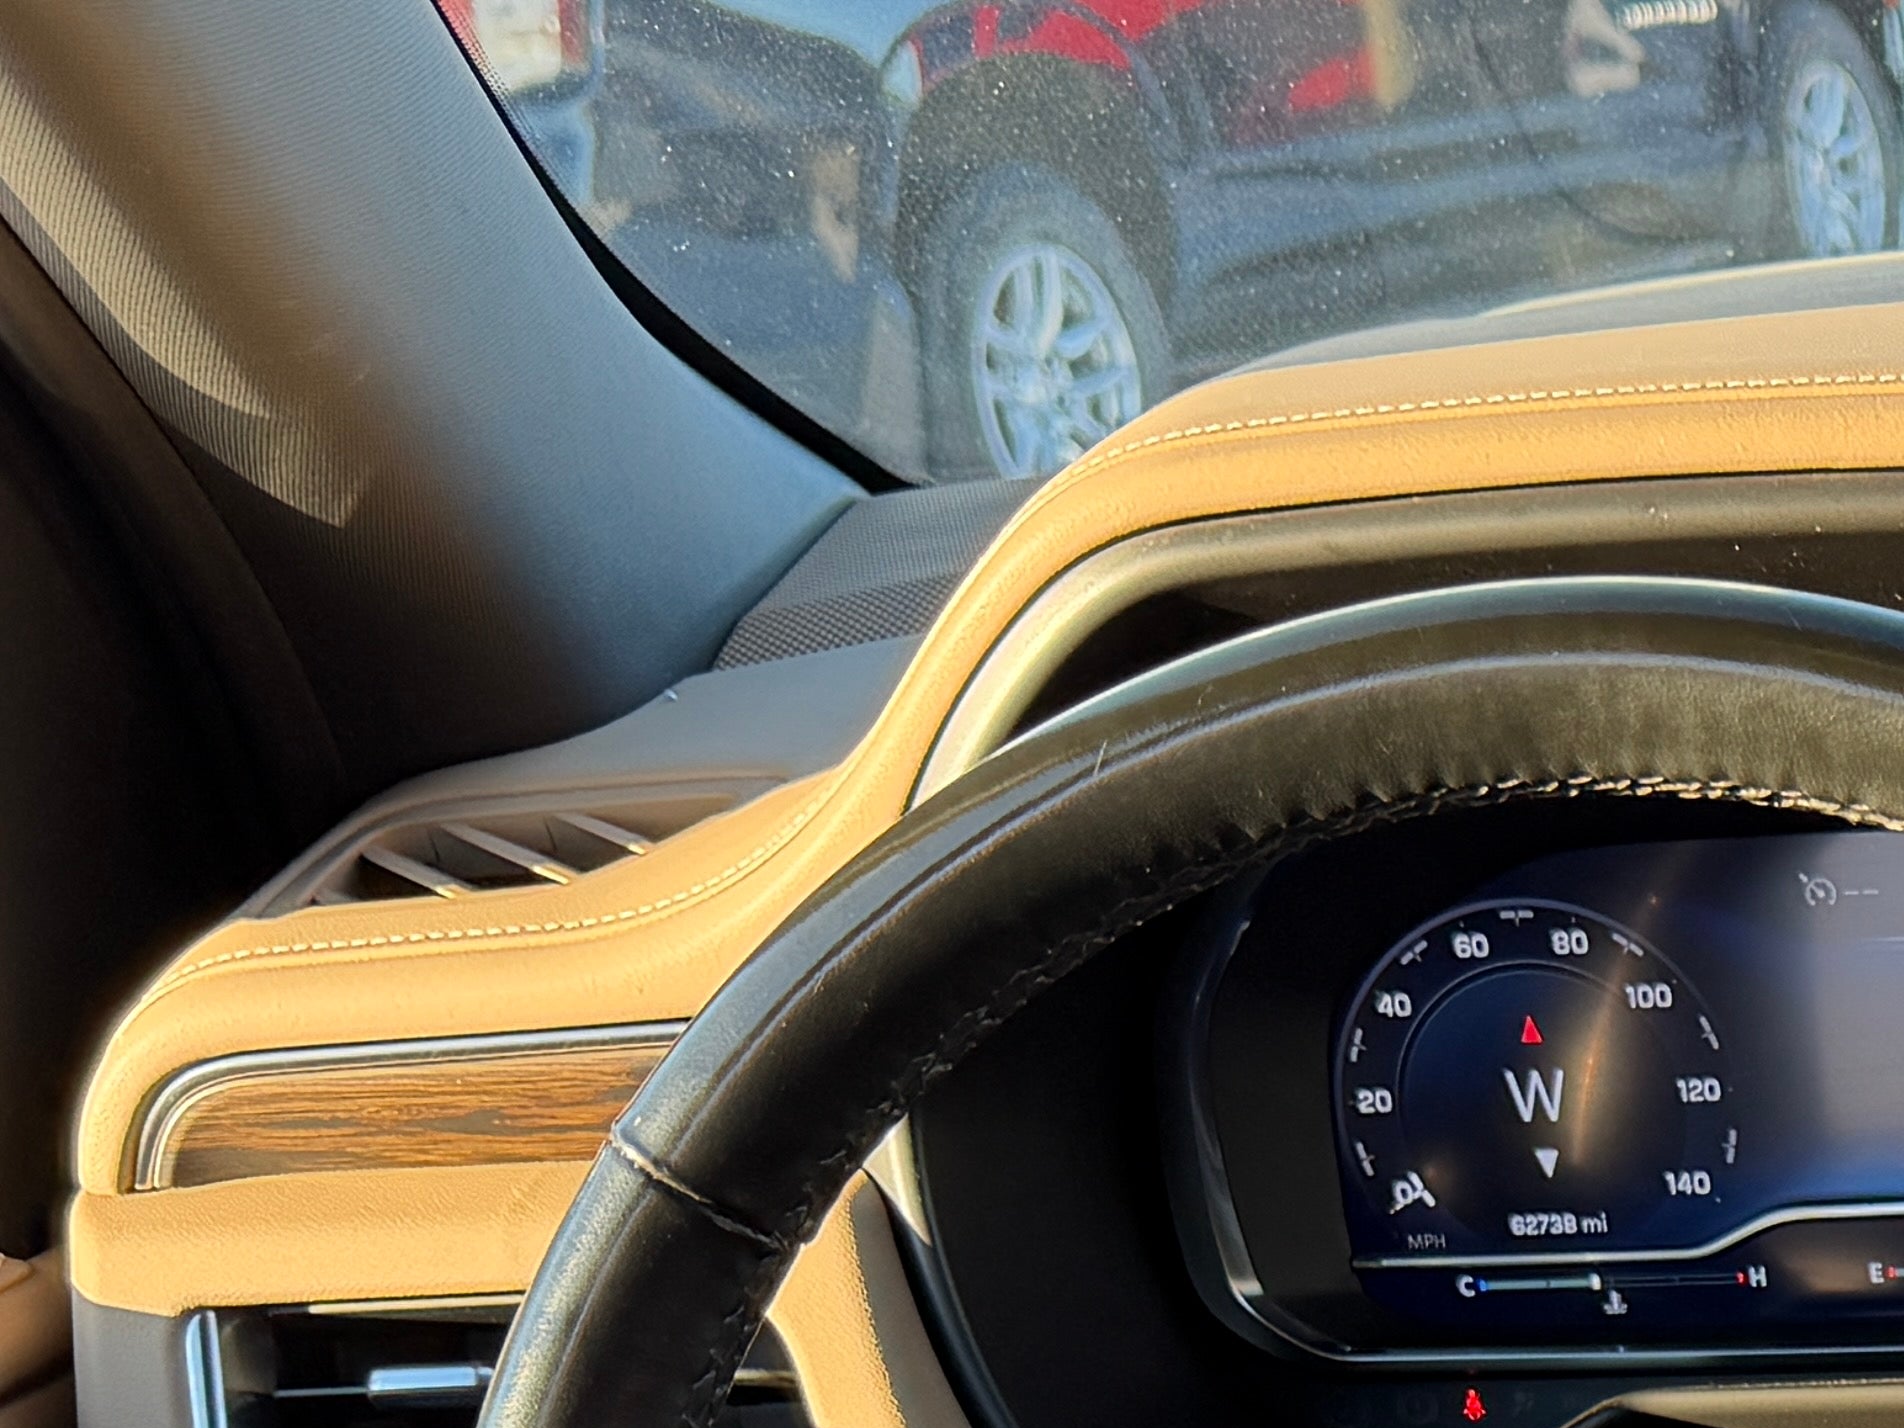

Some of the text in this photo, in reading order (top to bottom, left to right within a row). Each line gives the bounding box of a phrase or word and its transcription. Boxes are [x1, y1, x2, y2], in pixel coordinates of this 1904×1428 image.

[1451, 932, 1490, 959] 60
[1550, 928, 1590, 956] 80
[1375, 992, 1412, 1019] 40
[1625, 982, 1673, 1010] 100
[1355, 1086, 1393, 1115] 20
[1502, 1066, 1565, 1124] W
[1676, 1076, 1722, 1103] 120
[1663, 1169, 1712, 1196] 140
[1580, 1210, 1609, 1235] mi
[1407, 1233, 1446, 1251] MPH
[1455, 1274, 1475, 1298] C
[1748, 1264, 1767, 1289] H
[1868, 1261, 1885, 1284] E
